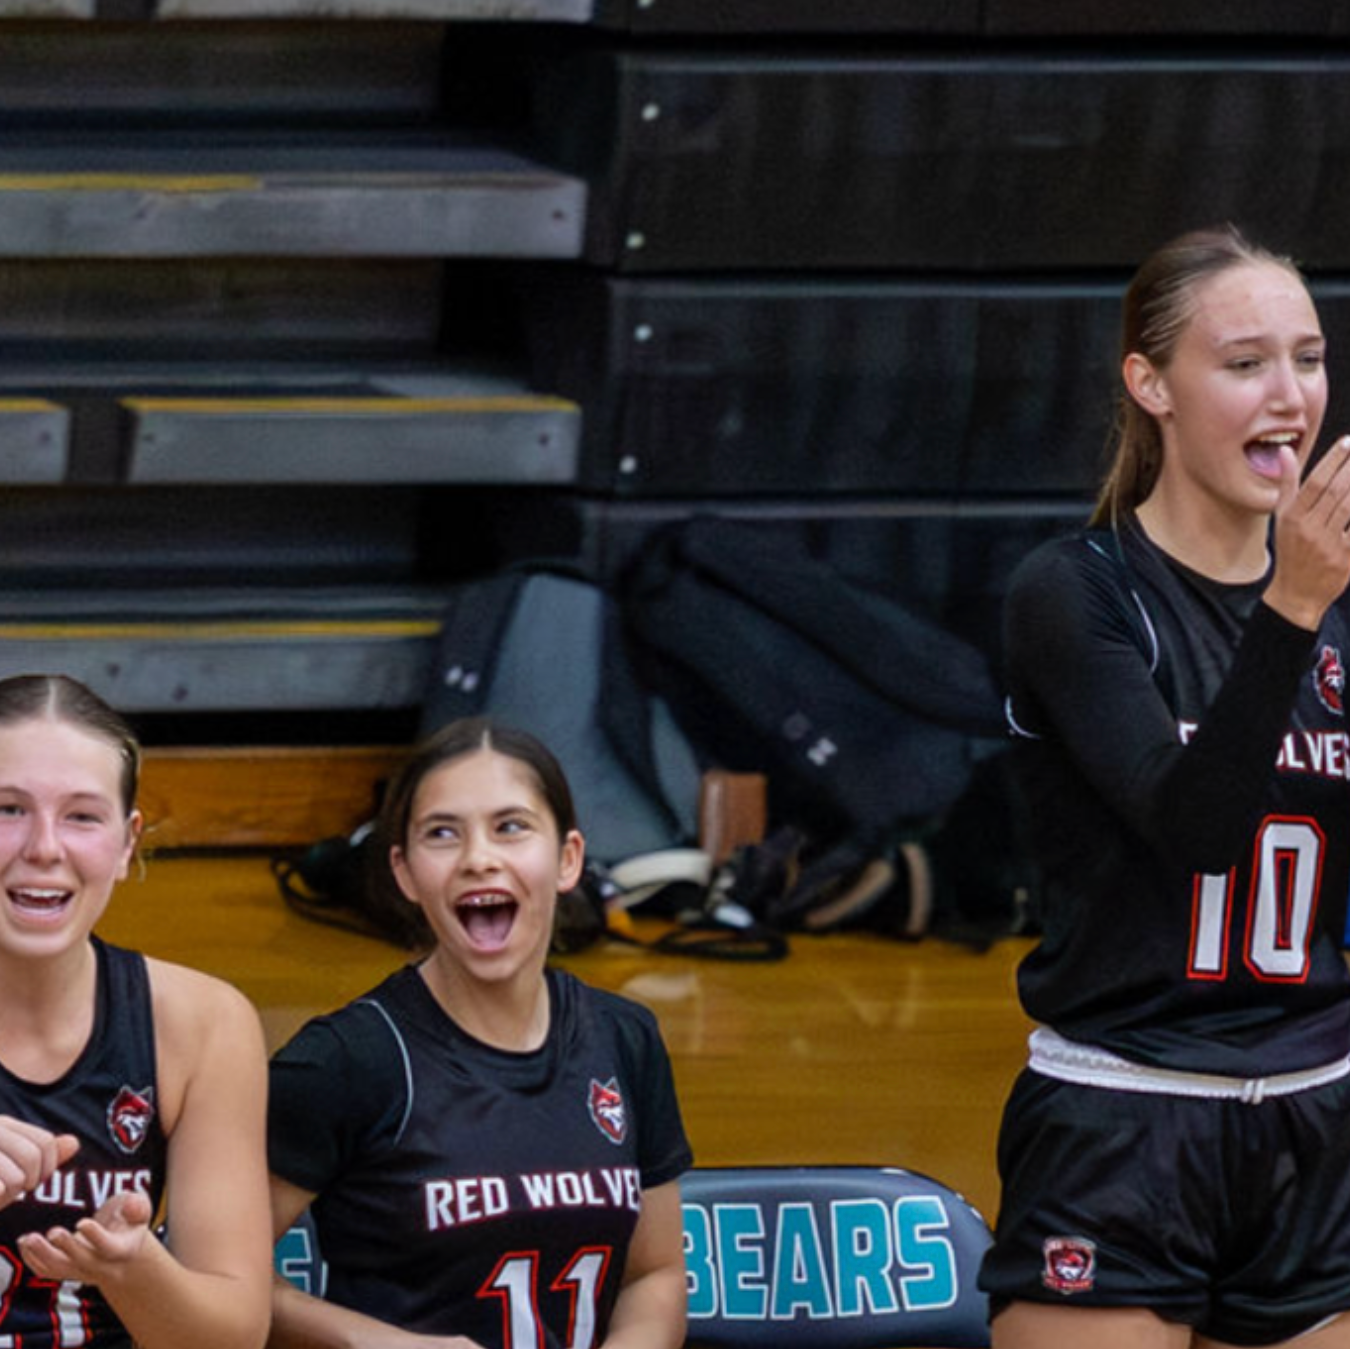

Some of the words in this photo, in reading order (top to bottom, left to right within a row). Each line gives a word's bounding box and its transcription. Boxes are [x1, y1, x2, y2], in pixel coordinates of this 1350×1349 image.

[1186, 813, 1326, 984] 10
[14, 1168, 152, 1209] OLVES
[425, 1176, 509, 1232] RED
[681, 1195, 958, 1320] BEARS
